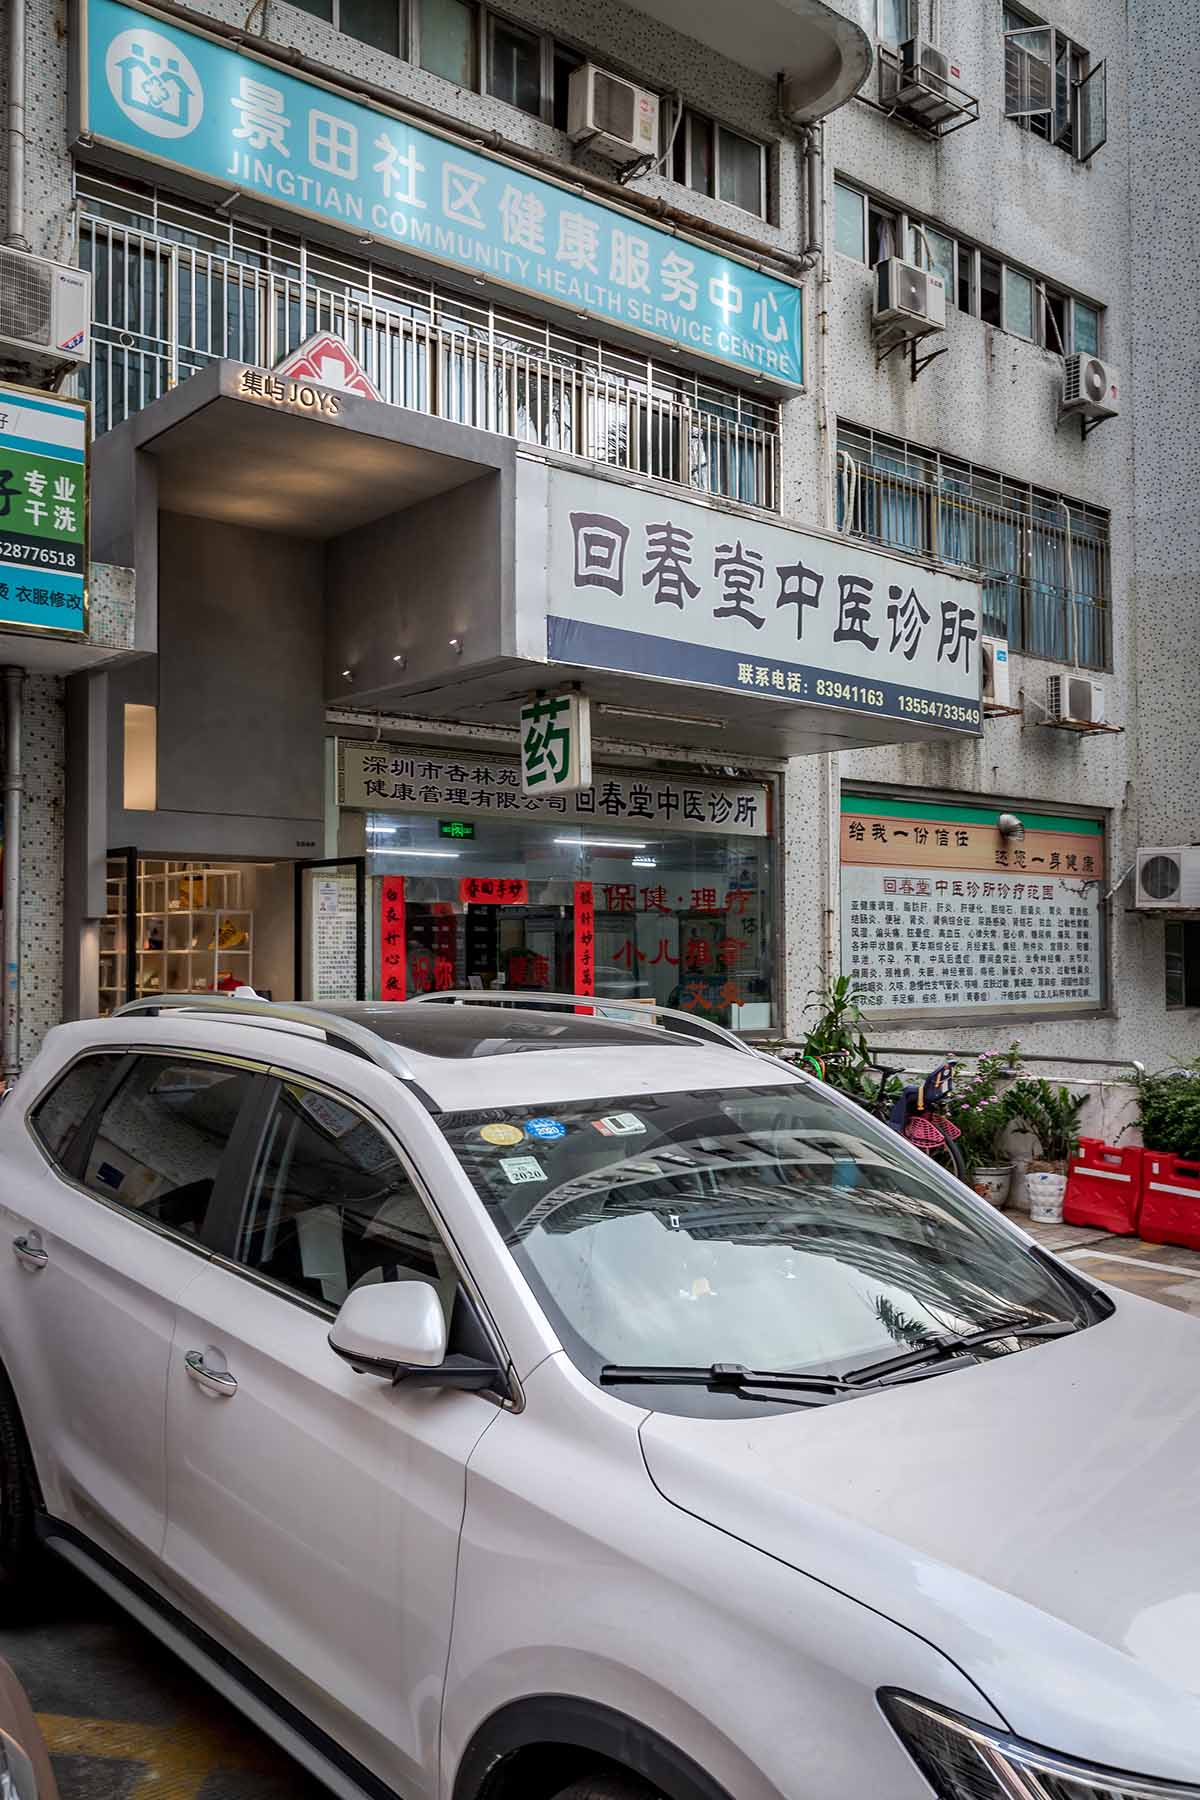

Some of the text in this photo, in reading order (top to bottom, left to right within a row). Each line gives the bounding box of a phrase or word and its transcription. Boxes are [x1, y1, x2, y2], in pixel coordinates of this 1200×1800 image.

[230, 76, 788, 342] 景田社区健康服务中心
[227, 152, 791, 375] JINGTIAN COMMUNITY HEALTH SERVICE CENTRE
[241, 370, 341, 414] 集屿 JOYS
[24, 470, 76, 502] 专业
[24, 500, 77, 532] 干洗
[16, 586, 82, 610] 衣服修改
[569, 511, 978, 673] 回春堂中医诊所
[898, 694, 980, 725] 13554733549
[522, 698, 570, 786] 药
[362, 756, 520, 787] 深圳市杏林苑
[363, 778, 567, 813] 健康管理有限公司
[576, 781, 757, 827] 回春堂中医诊所
[849, 821, 969, 847] 给我一份信任
[883, 879, 1054, 900] 回春堂中医诊所诊疗范围
[512, 1170, 542, 1181] 2020
